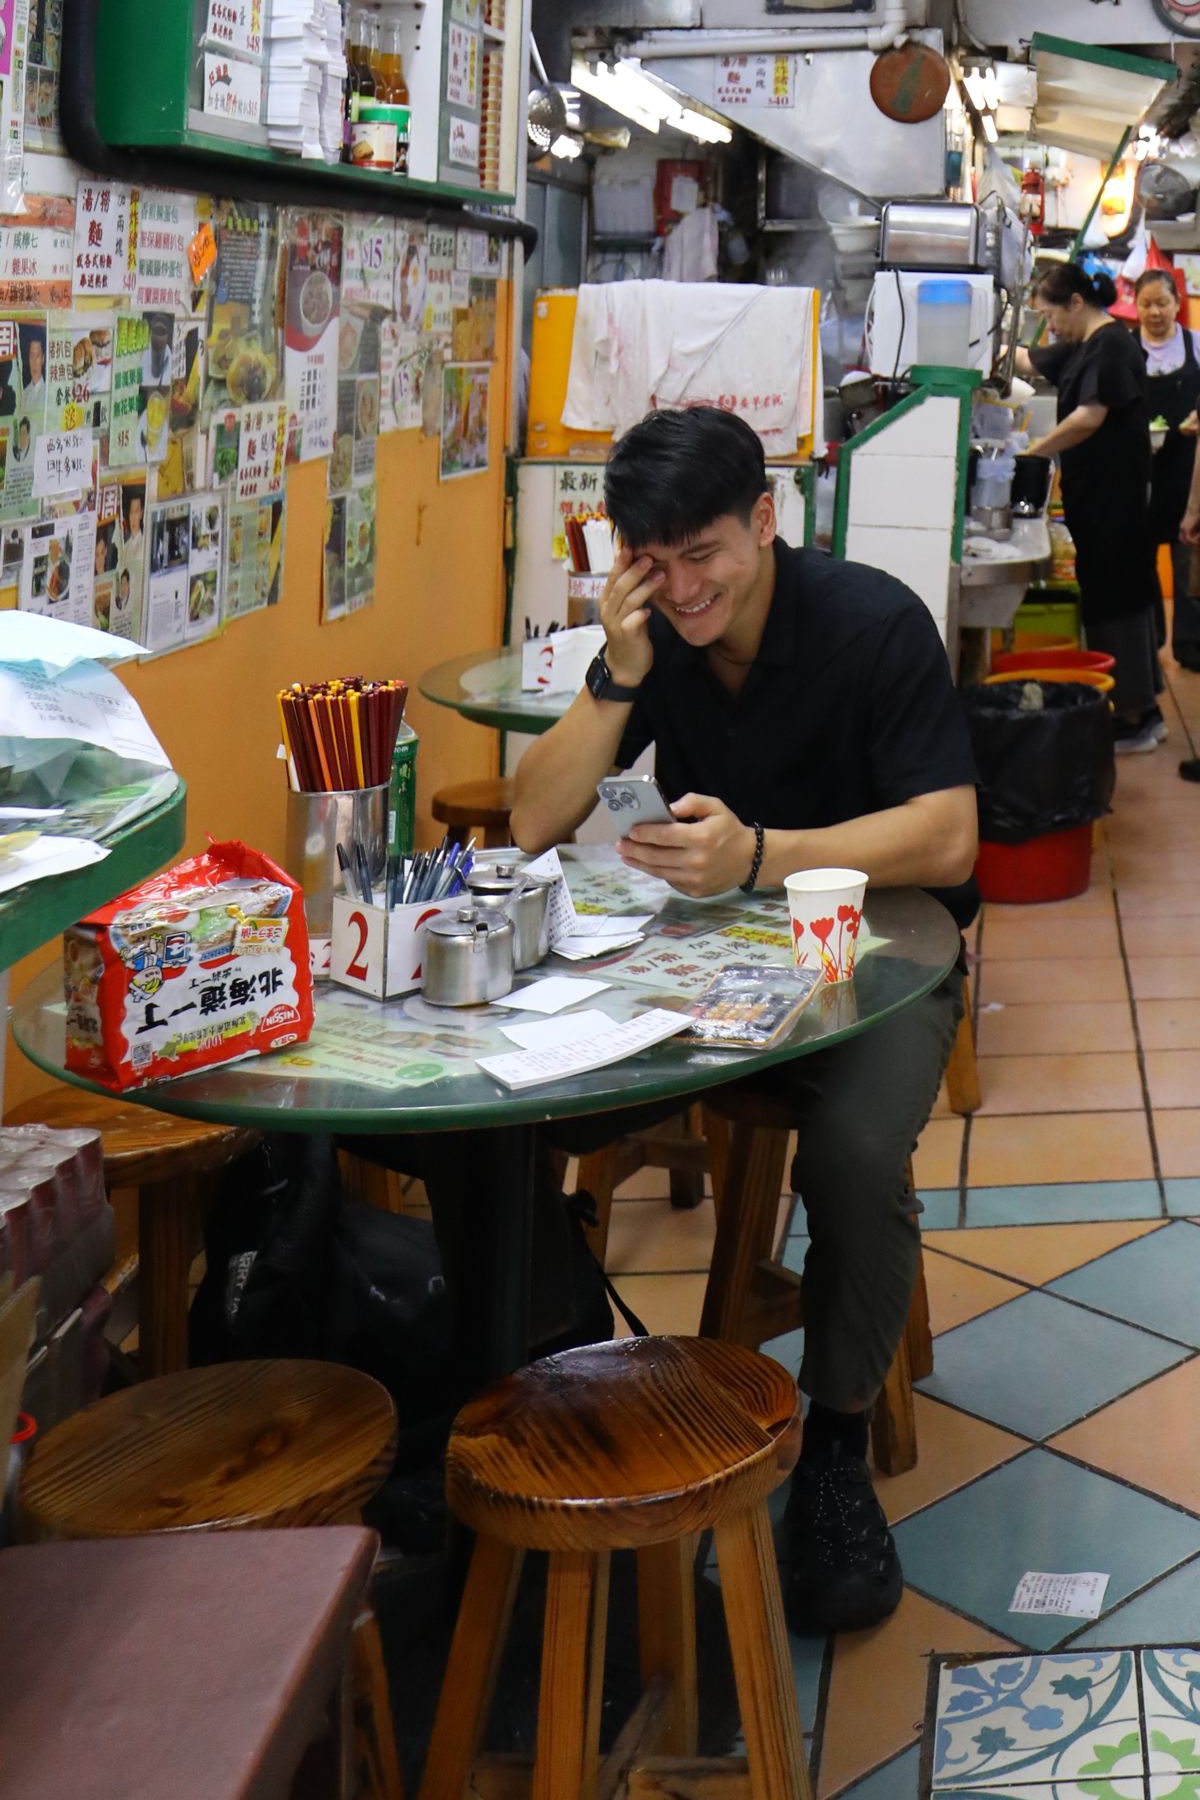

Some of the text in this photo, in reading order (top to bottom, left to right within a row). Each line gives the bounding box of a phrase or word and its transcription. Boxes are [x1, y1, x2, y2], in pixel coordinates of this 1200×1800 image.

[345, 911, 369, 981] 2
[135, 967, 286, 1035] 北海道一丁
[265, 1008, 296, 1027] NISSIN
